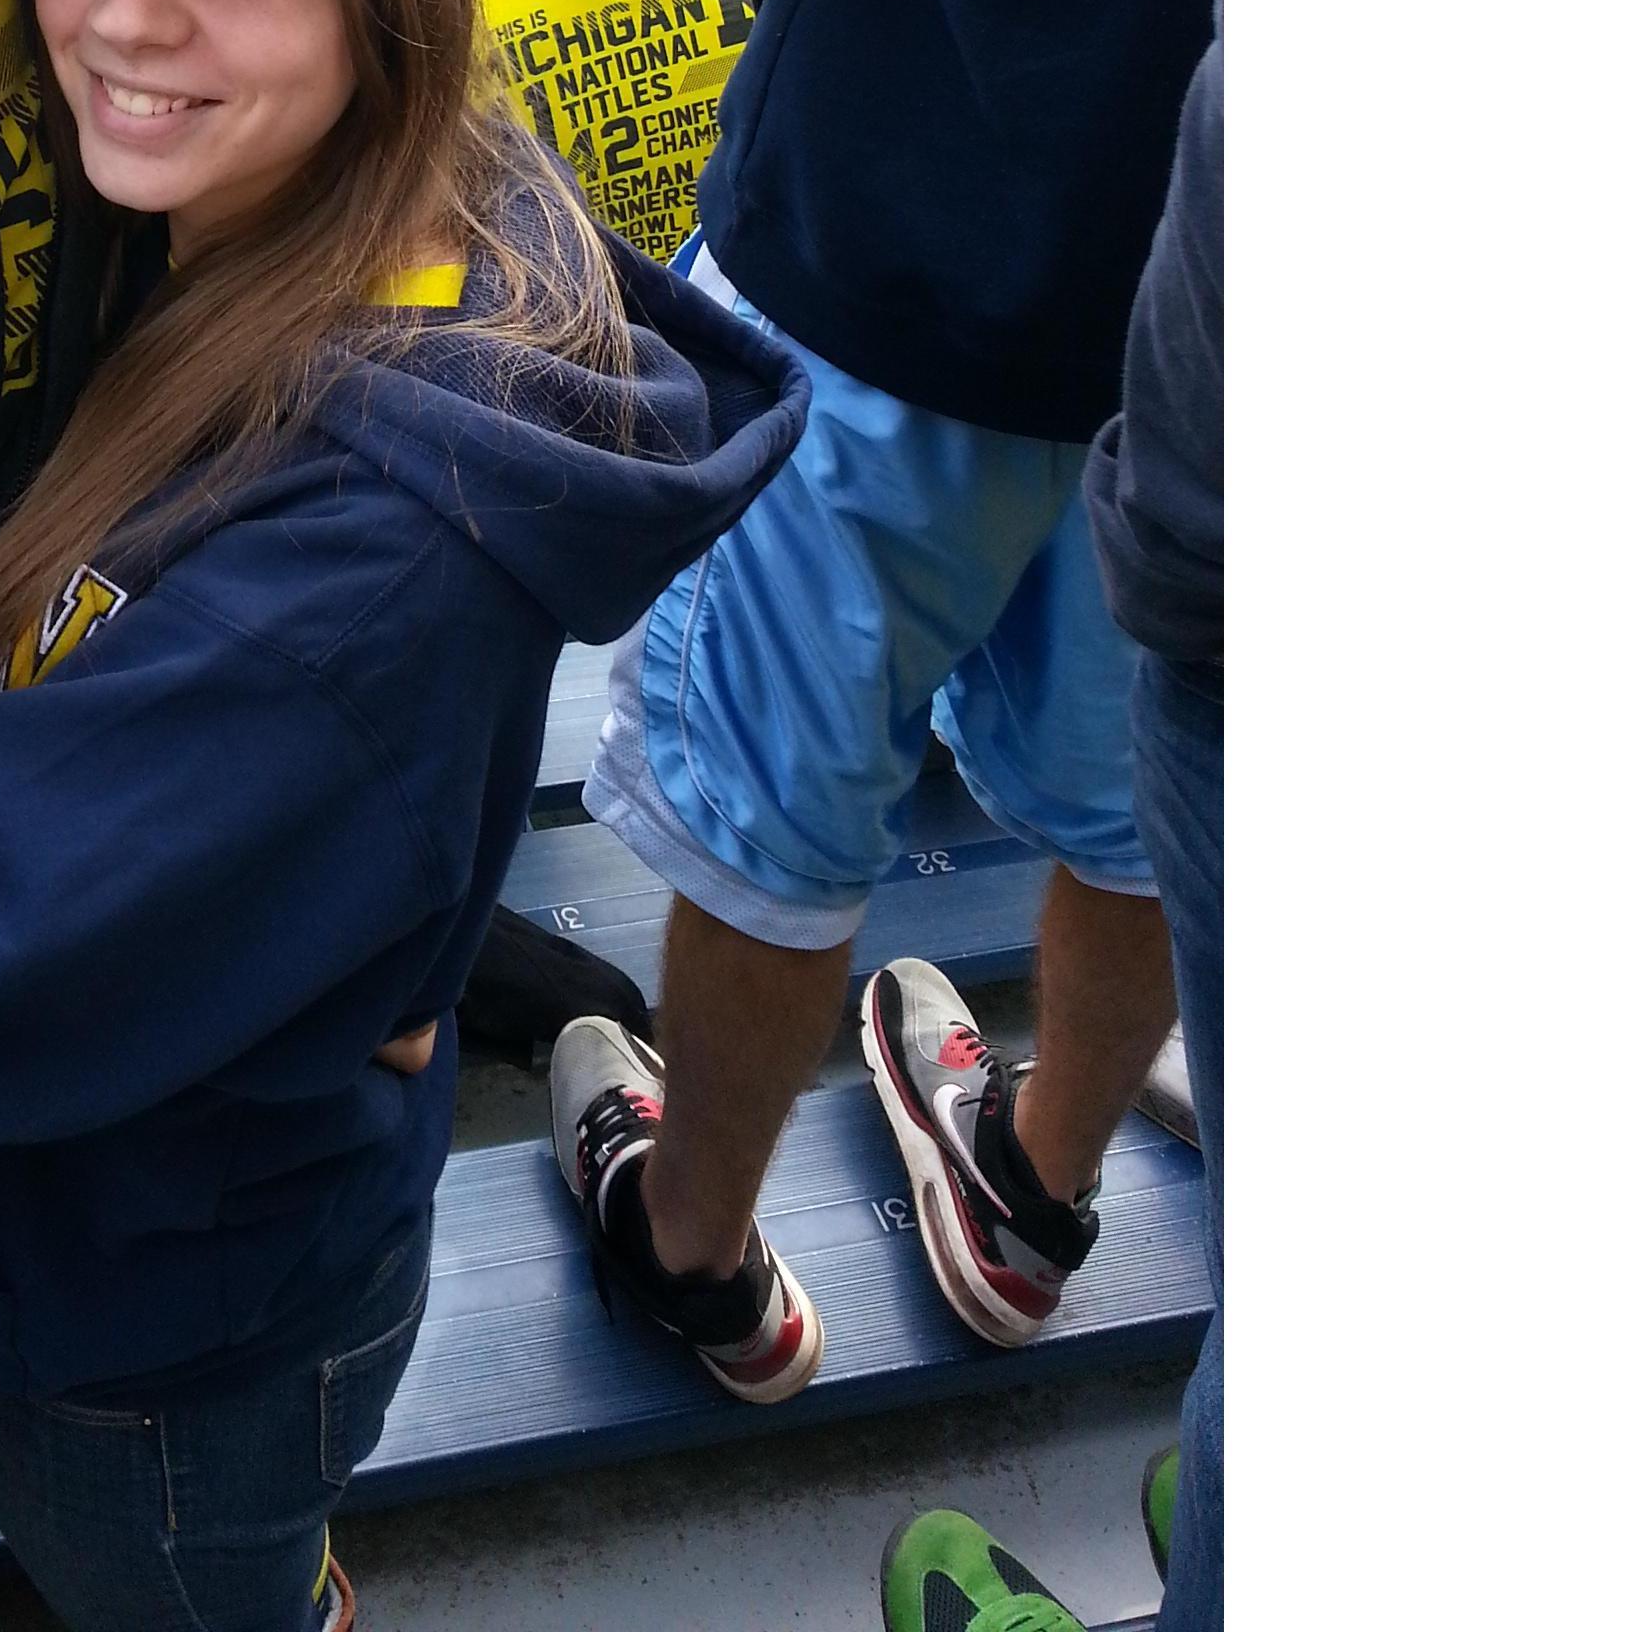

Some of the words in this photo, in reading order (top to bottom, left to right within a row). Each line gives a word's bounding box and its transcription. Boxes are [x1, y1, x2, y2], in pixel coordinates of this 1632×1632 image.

[490, 18, 526, 43] HIS
[529, 9, 548, 29] IS
[554, 29, 709, 101] NATIONAL
[561, 72, 673, 130] TITLES
[641, 97, 718, 137] CONFE
[568, 115, 644, 184] 42
[909, 850, 956, 875] 32
[552, 905, 585, 931] 31
[873, 1198, 915, 1233] 31
